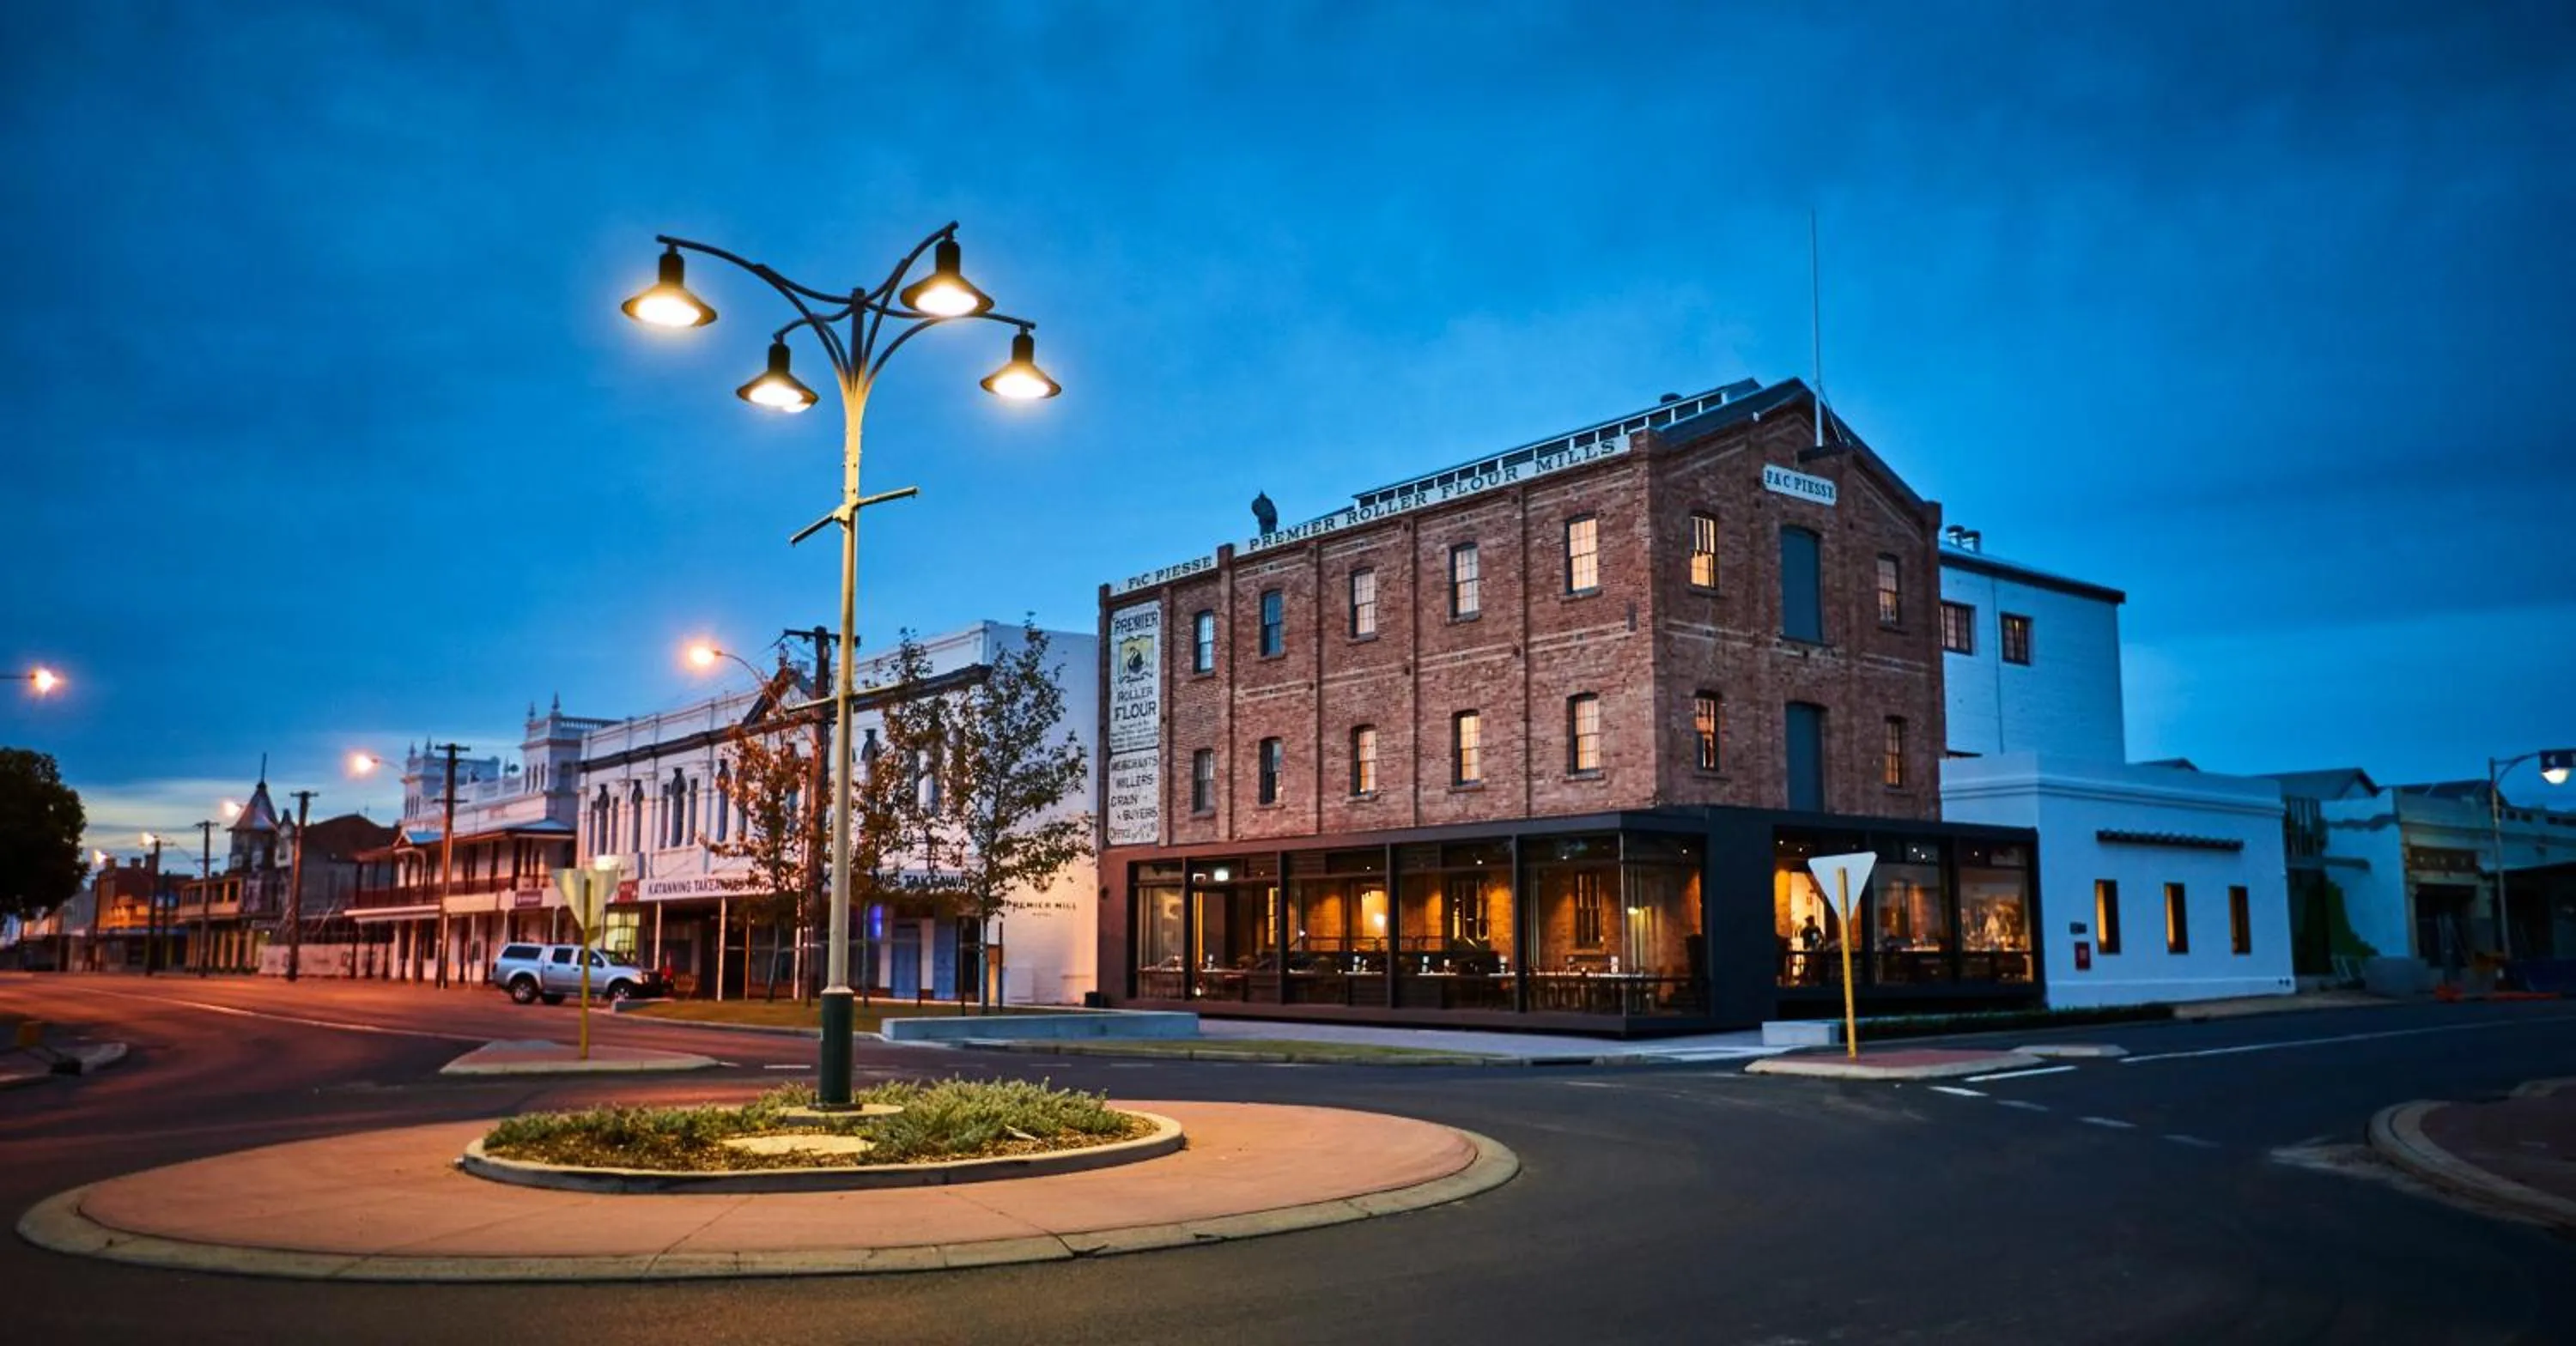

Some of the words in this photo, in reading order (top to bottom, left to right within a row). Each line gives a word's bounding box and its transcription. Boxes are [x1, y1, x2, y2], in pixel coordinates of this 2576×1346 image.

[1249, 517, 1336, 551] PREMIER
[1346, 491, 1428, 525] ROLLER
[1442, 467, 1518, 499] FLOUR
[1535, 440, 1615, 473] MILLS
[1794, 476, 1835, 499] PIESSE
[1155, 555, 1212, 582] PIESSE
[1114, 611, 1157, 636] PREMIER
[1117, 686, 1153, 703] ROLLER
[1115, 700, 1157, 722] FLOUR
[1110, 755, 1157, 772] MERCHANTS
[1110, 793, 1139, 809] GRAIN
[1122, 807, 1158, 821] BUYERS
[648, 880, 690, 894] KATANNING
